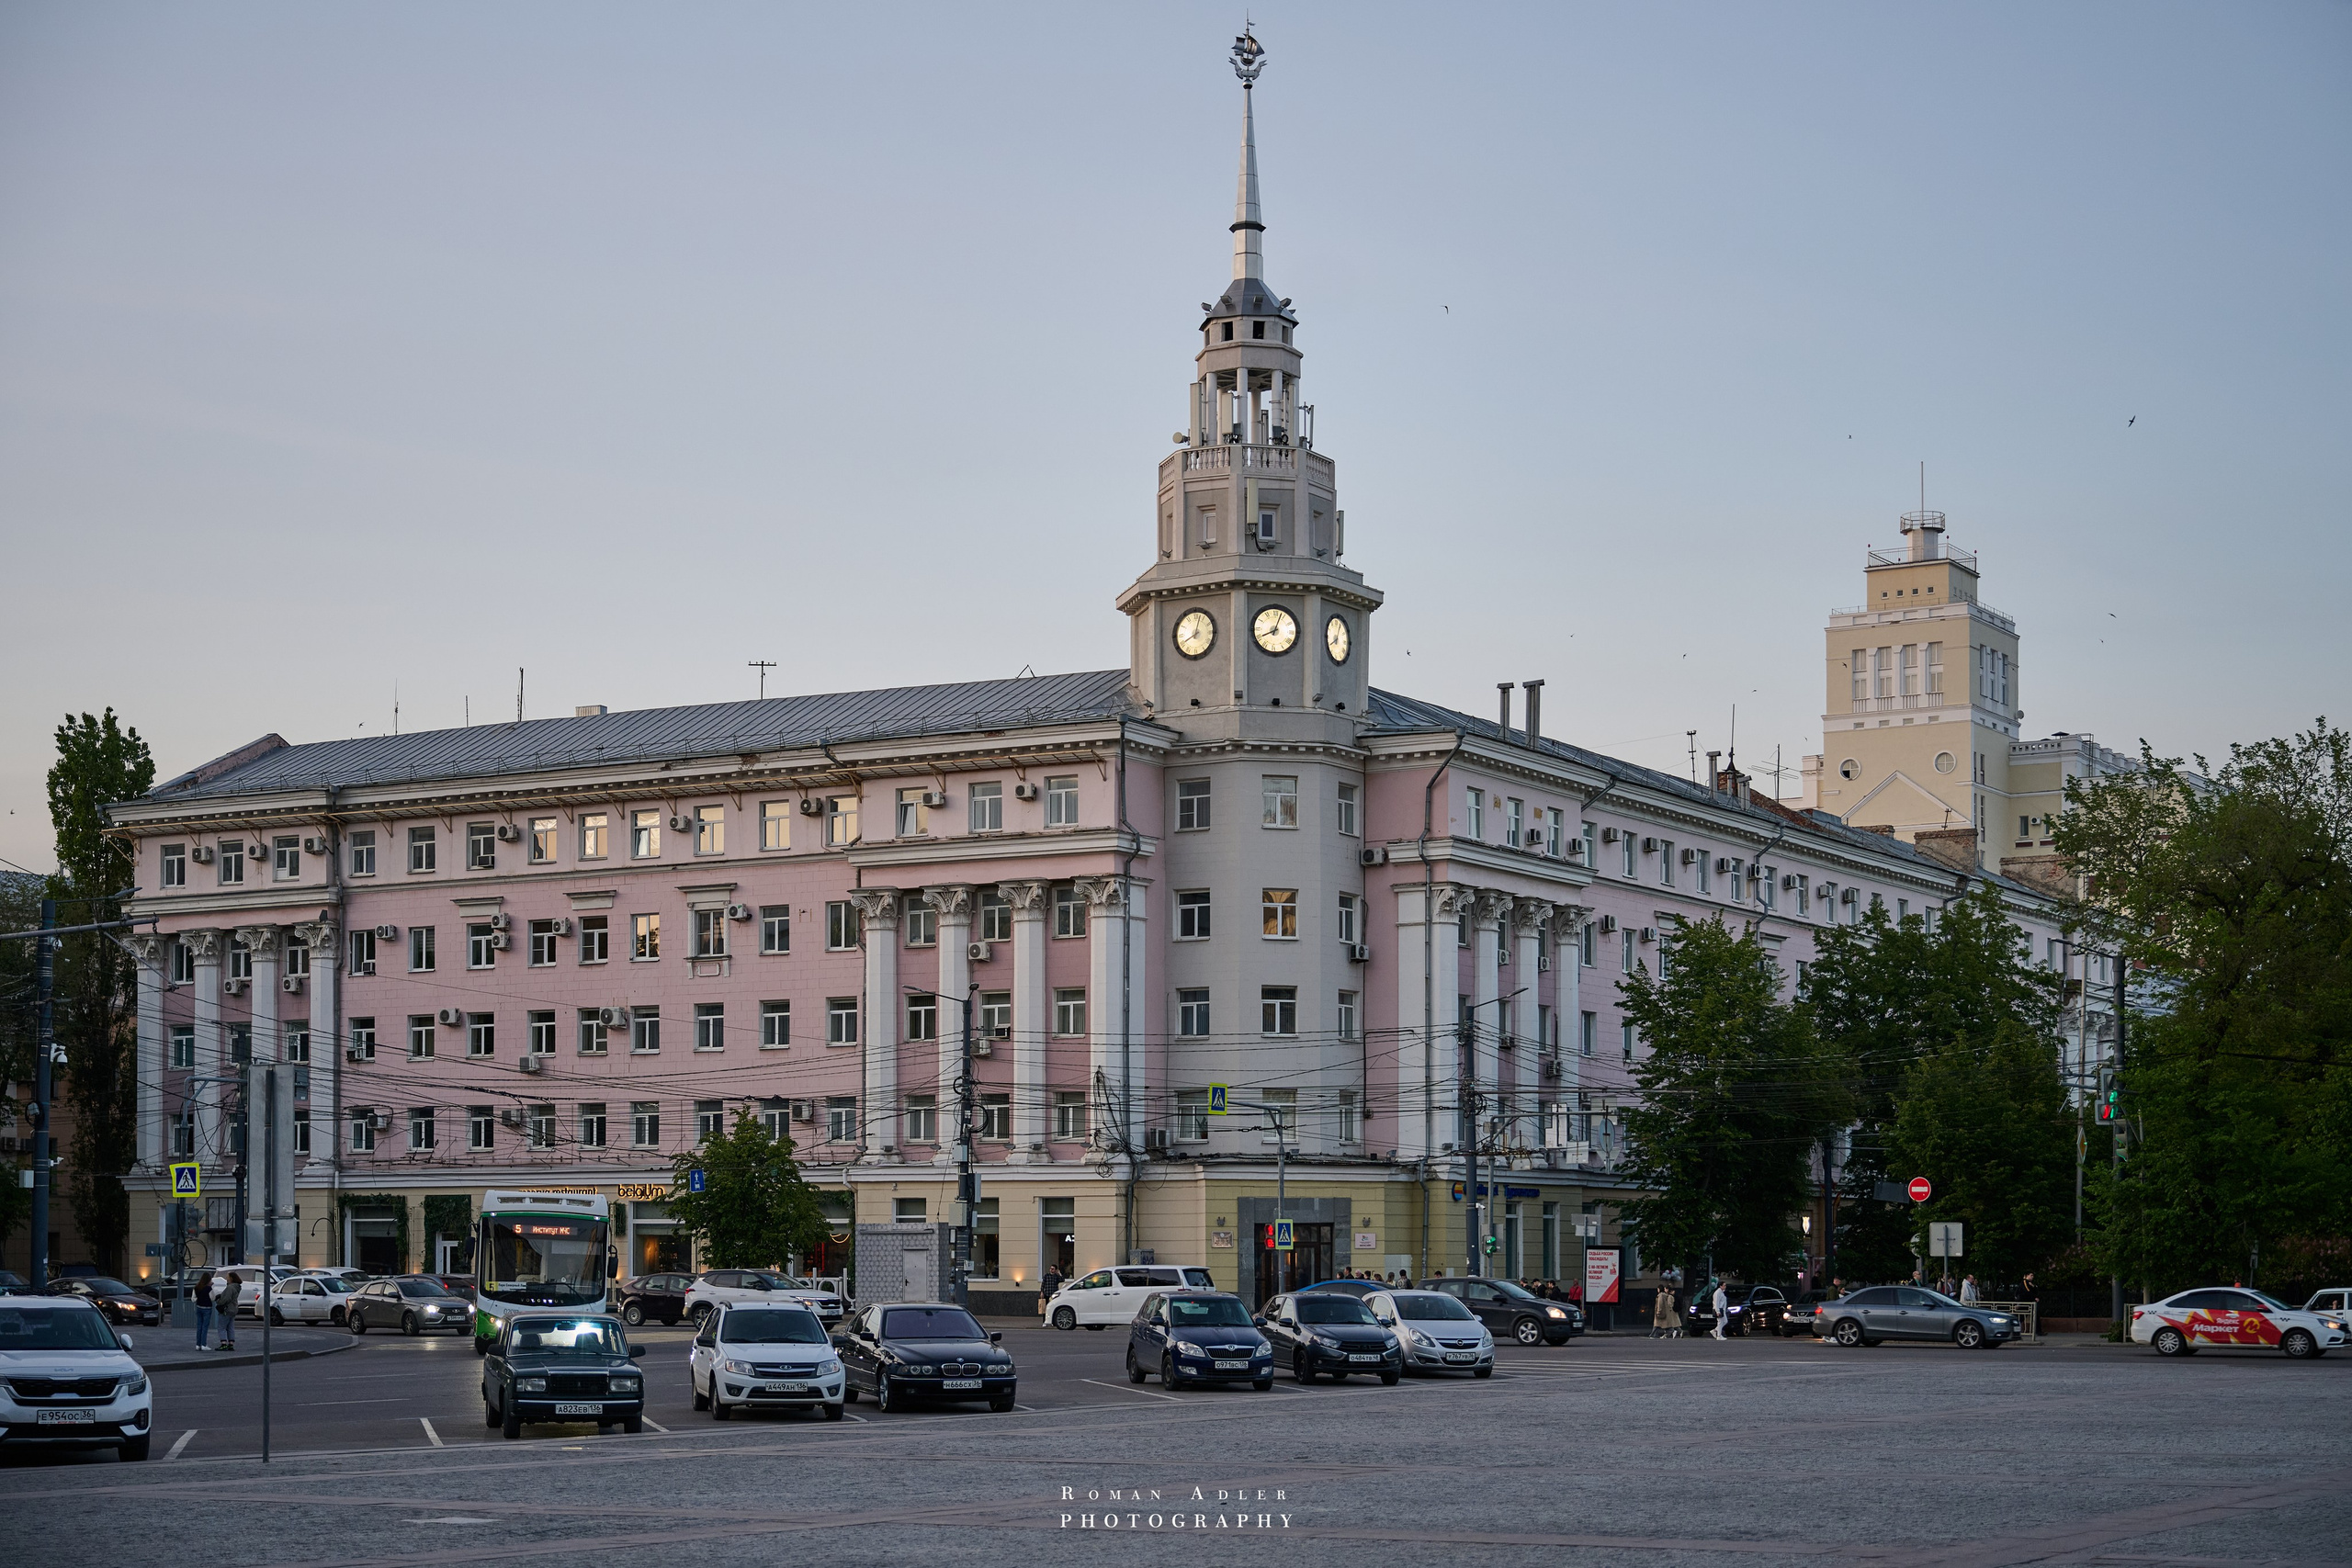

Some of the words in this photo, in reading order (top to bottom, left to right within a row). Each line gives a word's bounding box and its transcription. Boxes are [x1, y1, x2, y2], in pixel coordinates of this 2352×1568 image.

[514, 1224, 523, 1234] 5
[533, 1226, 558, 1235] Институт
[2192, 1324, 2240, 1334] Маркет
